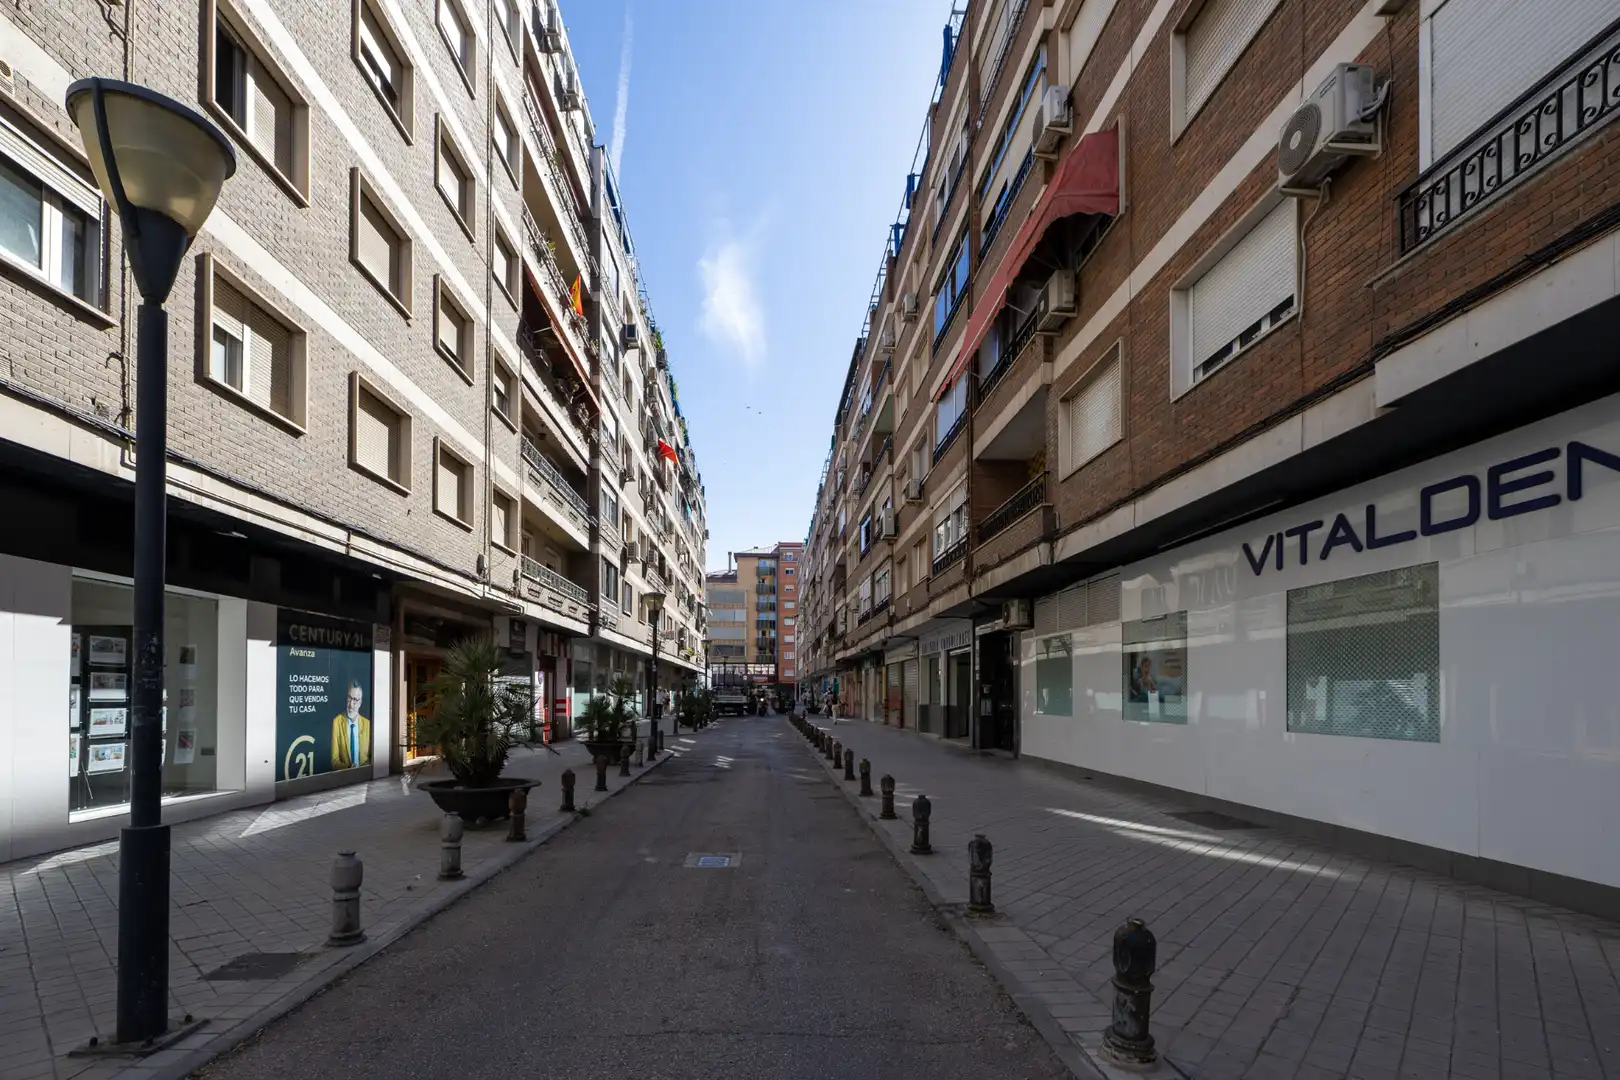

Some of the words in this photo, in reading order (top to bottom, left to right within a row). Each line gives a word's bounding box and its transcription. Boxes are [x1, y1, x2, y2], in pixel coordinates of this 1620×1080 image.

[289, 623, 351, 647] CENTURY
[353, 633, 364, 648] 21
[289, 647, 316, 658] Avanza
[289, 674, 298, 682] LO
[299, 675, 330, 683] HACEMOS
[289, 685, 308, 693] TODO
[308, 685, 325, 693] PARA
[289, 695, 304, 704] QUE
[304, 695, 329, 703] VENDAS
[289, 705, 298, 713] TU
[299, 705, 316, 713] CASA
